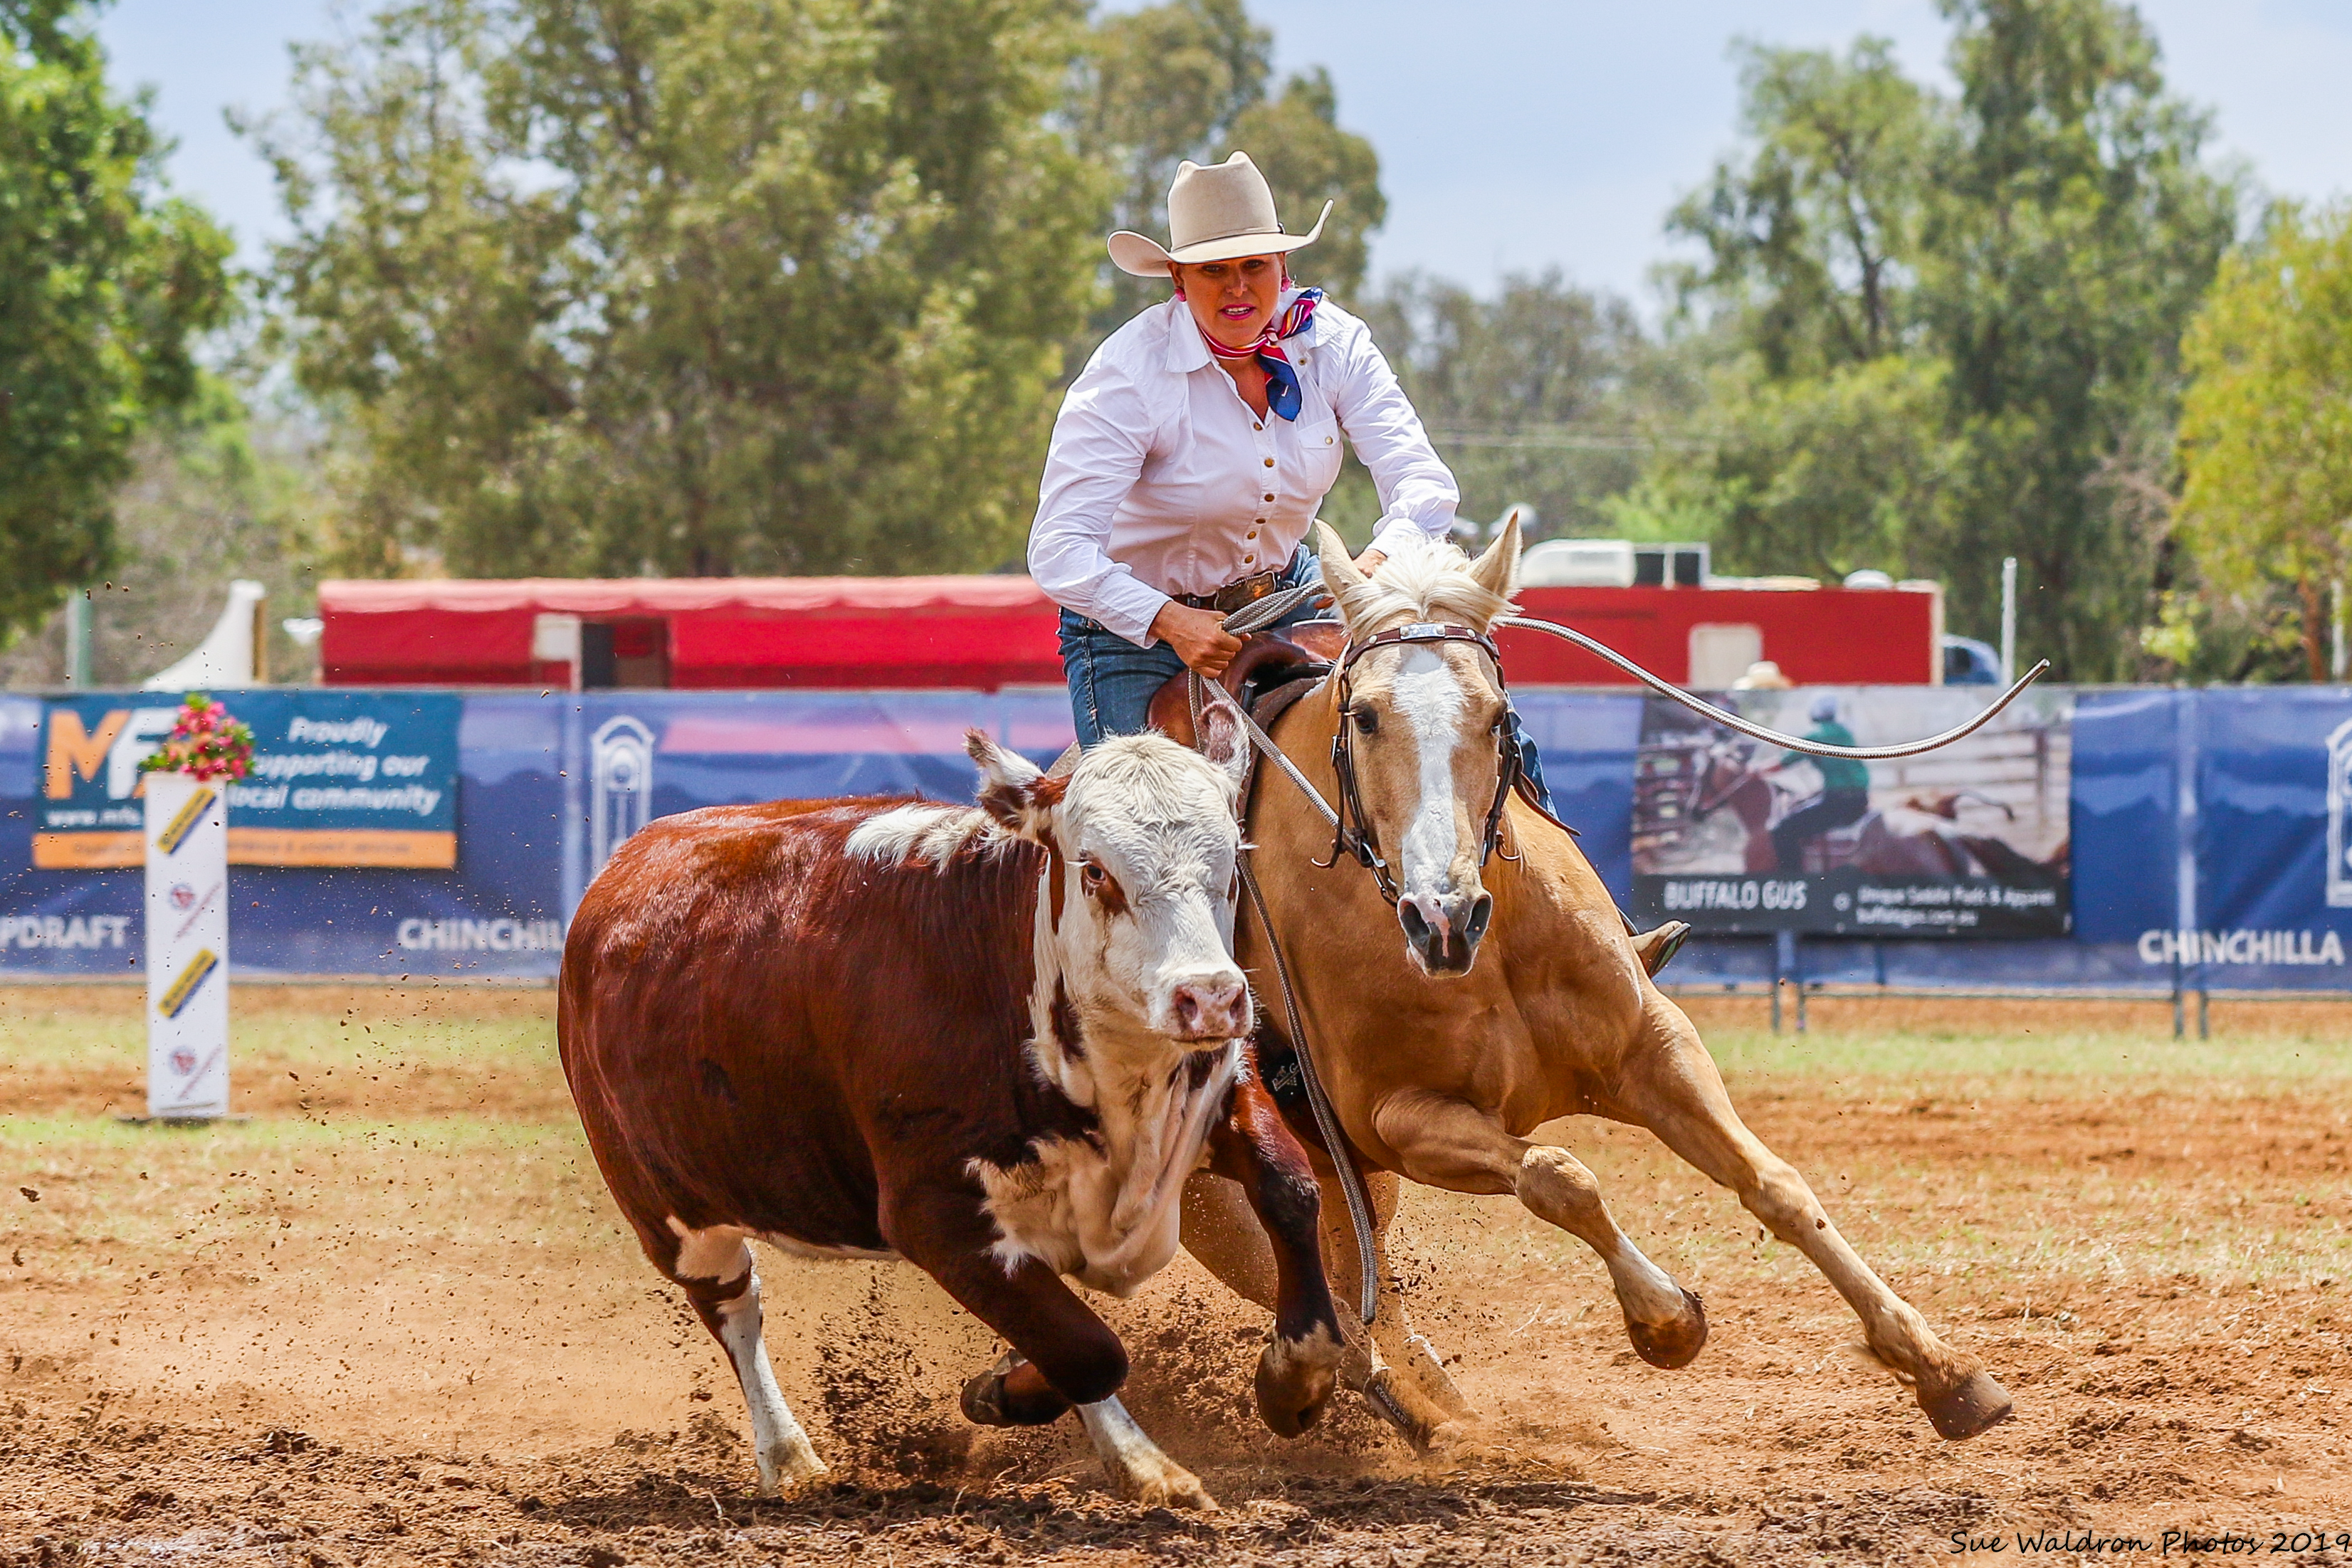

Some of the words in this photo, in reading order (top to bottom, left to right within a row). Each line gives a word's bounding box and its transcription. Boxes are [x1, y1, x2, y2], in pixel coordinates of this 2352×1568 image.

[288, 716, 388, 748] Proudly
[252, 749, 378, 782] upporting
[381, 754, 430, 777] our
[227, 783, 290, 809] local
[291, 784, 441, 816] community
[1663, 880, 1760, 911] BUFFALO
[1762, 879, 1808, 911] GUS
[397, 917, 567, 951] CHINCHIL
[2137, 929, 2346, 966] CHINCHILLA
